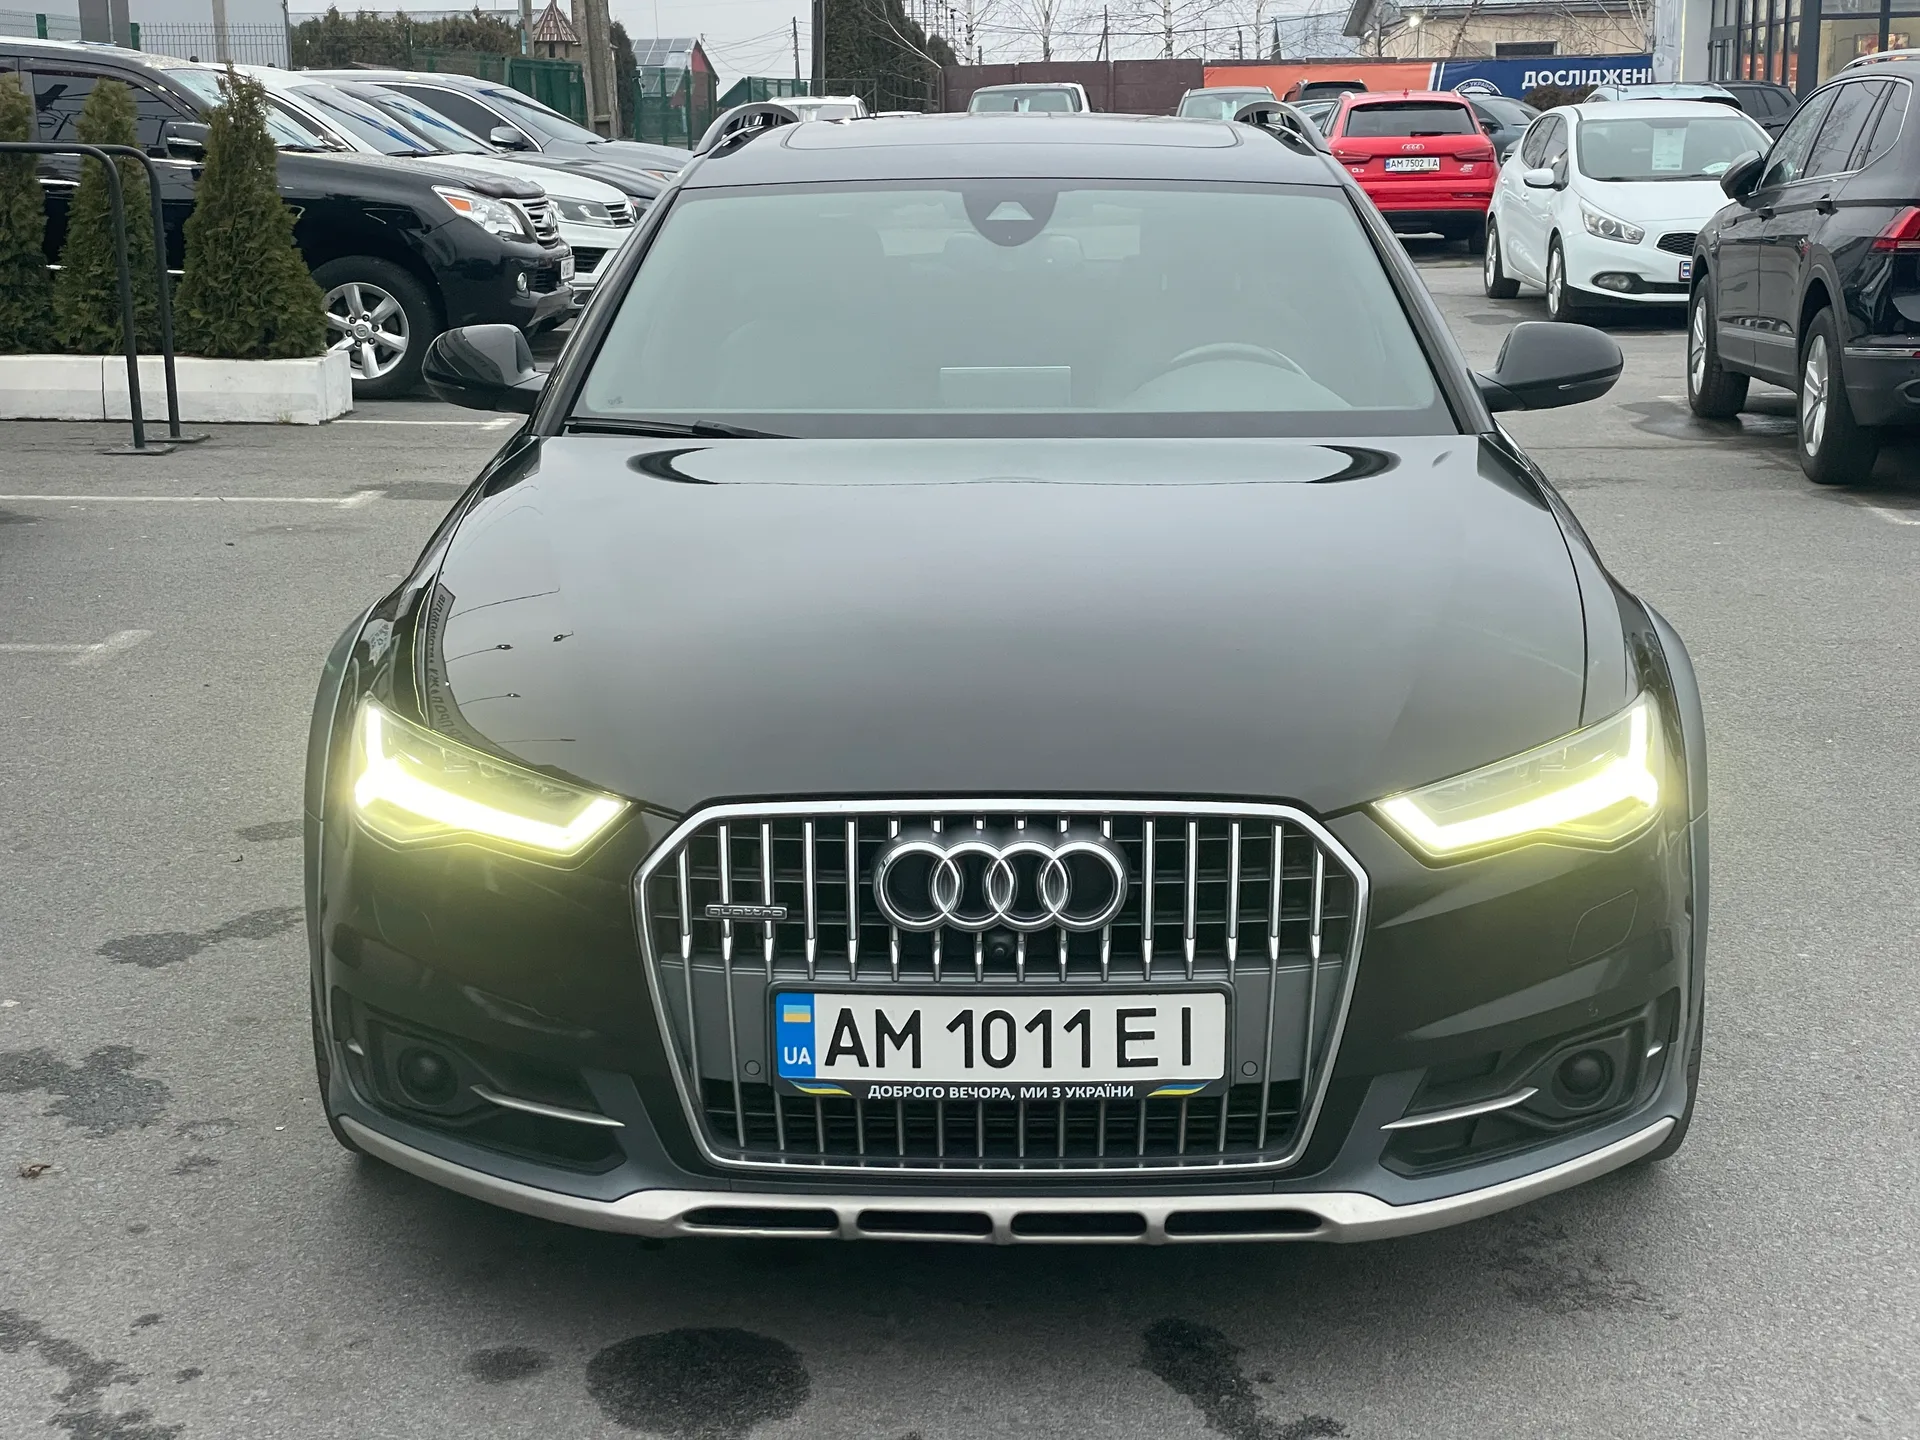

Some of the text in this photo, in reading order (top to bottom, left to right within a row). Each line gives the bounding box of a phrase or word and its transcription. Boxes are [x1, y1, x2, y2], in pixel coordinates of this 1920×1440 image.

[1405, 159, 1424, 167] 7502
[708, 907, 783, 917] quattro
[824, 1006, 1192, 1069] AM 1011 EI
[783, 1047, 812, 1066] UA
[868, 1083, 1134, 1101] ДОБРОГО ВЕЧОРА, МИ З УКРАЇНИ
